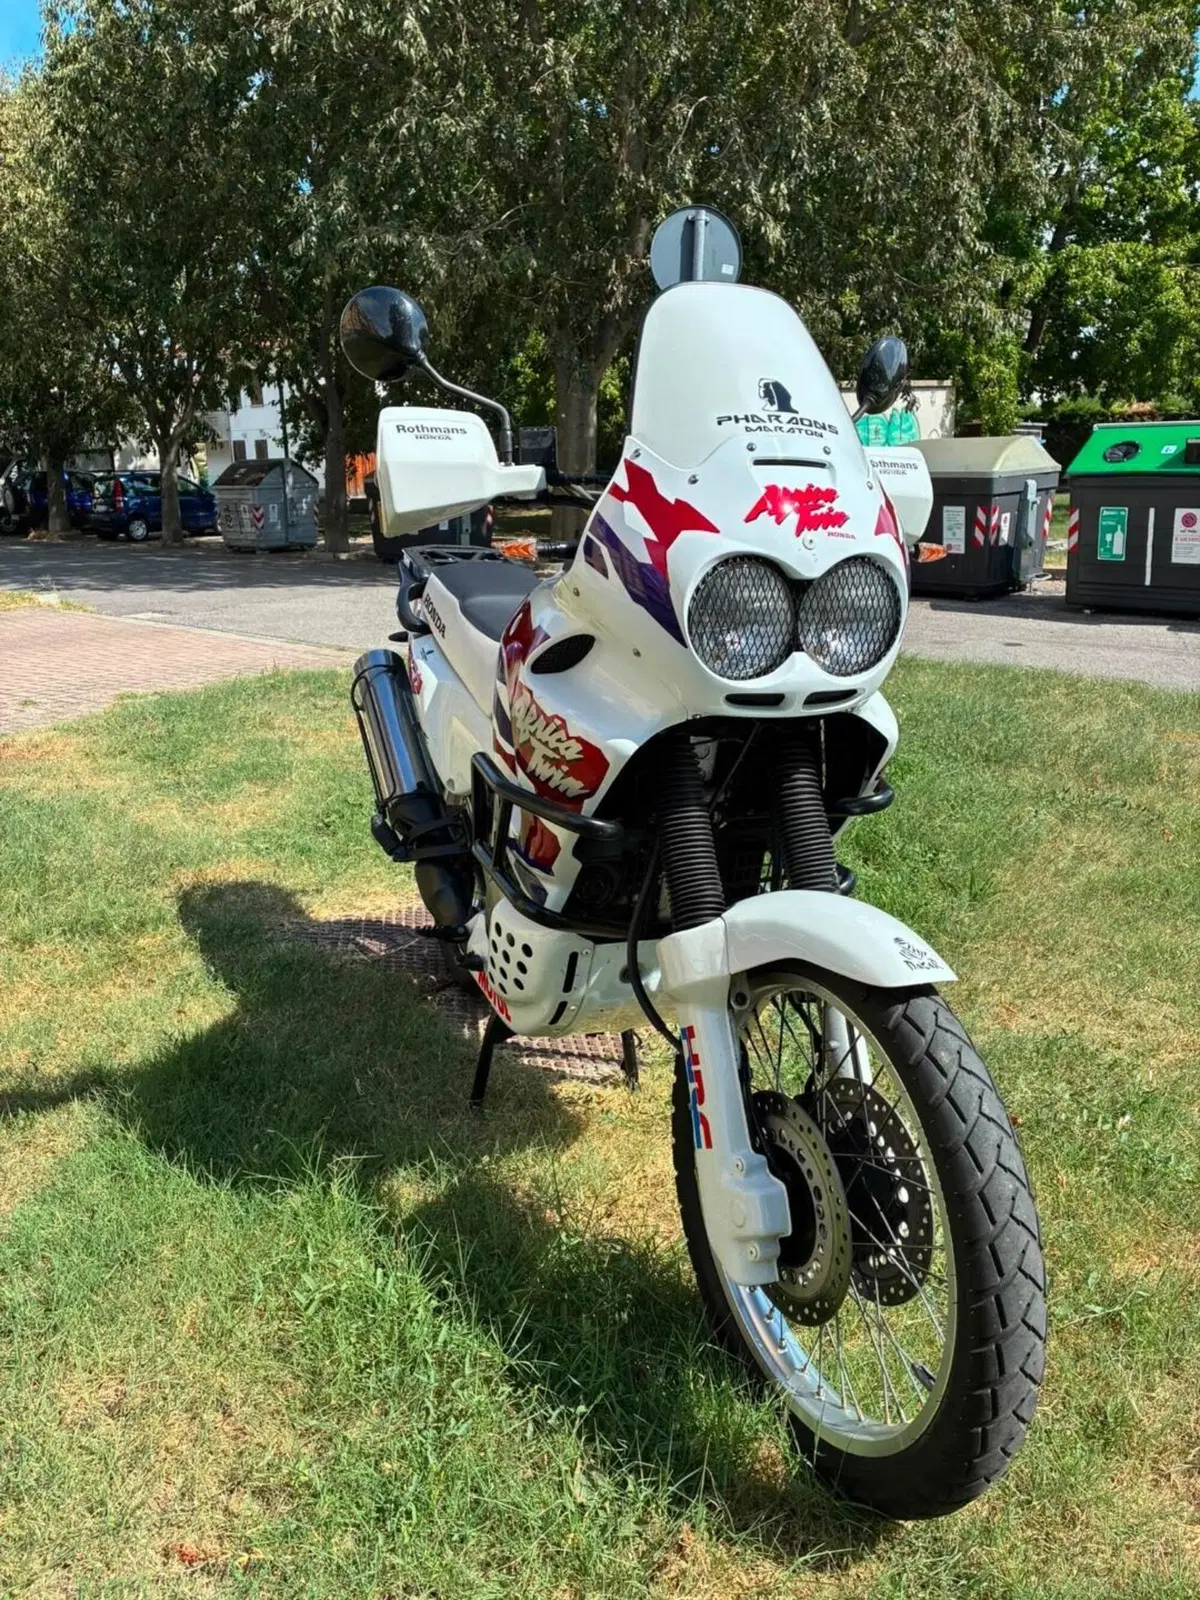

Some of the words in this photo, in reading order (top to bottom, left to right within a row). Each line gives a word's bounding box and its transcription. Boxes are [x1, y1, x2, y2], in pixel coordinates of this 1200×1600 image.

[396, 424, 467, 434] Rothmans
[716, 413, 839, 435] PHARAONS
[744, 425, 824, 438] MARATON
[869, 459, 918, 470] othmans
[743, 483, 840, 526] Africa
[795, 502, 850, 538] Twin
[423, 593, 446, 640] HONDA
[512, 692, 586, 761] Africa
[526, 736, 590, 799] Twin
[680, 1024, 714, 1150] HRC
